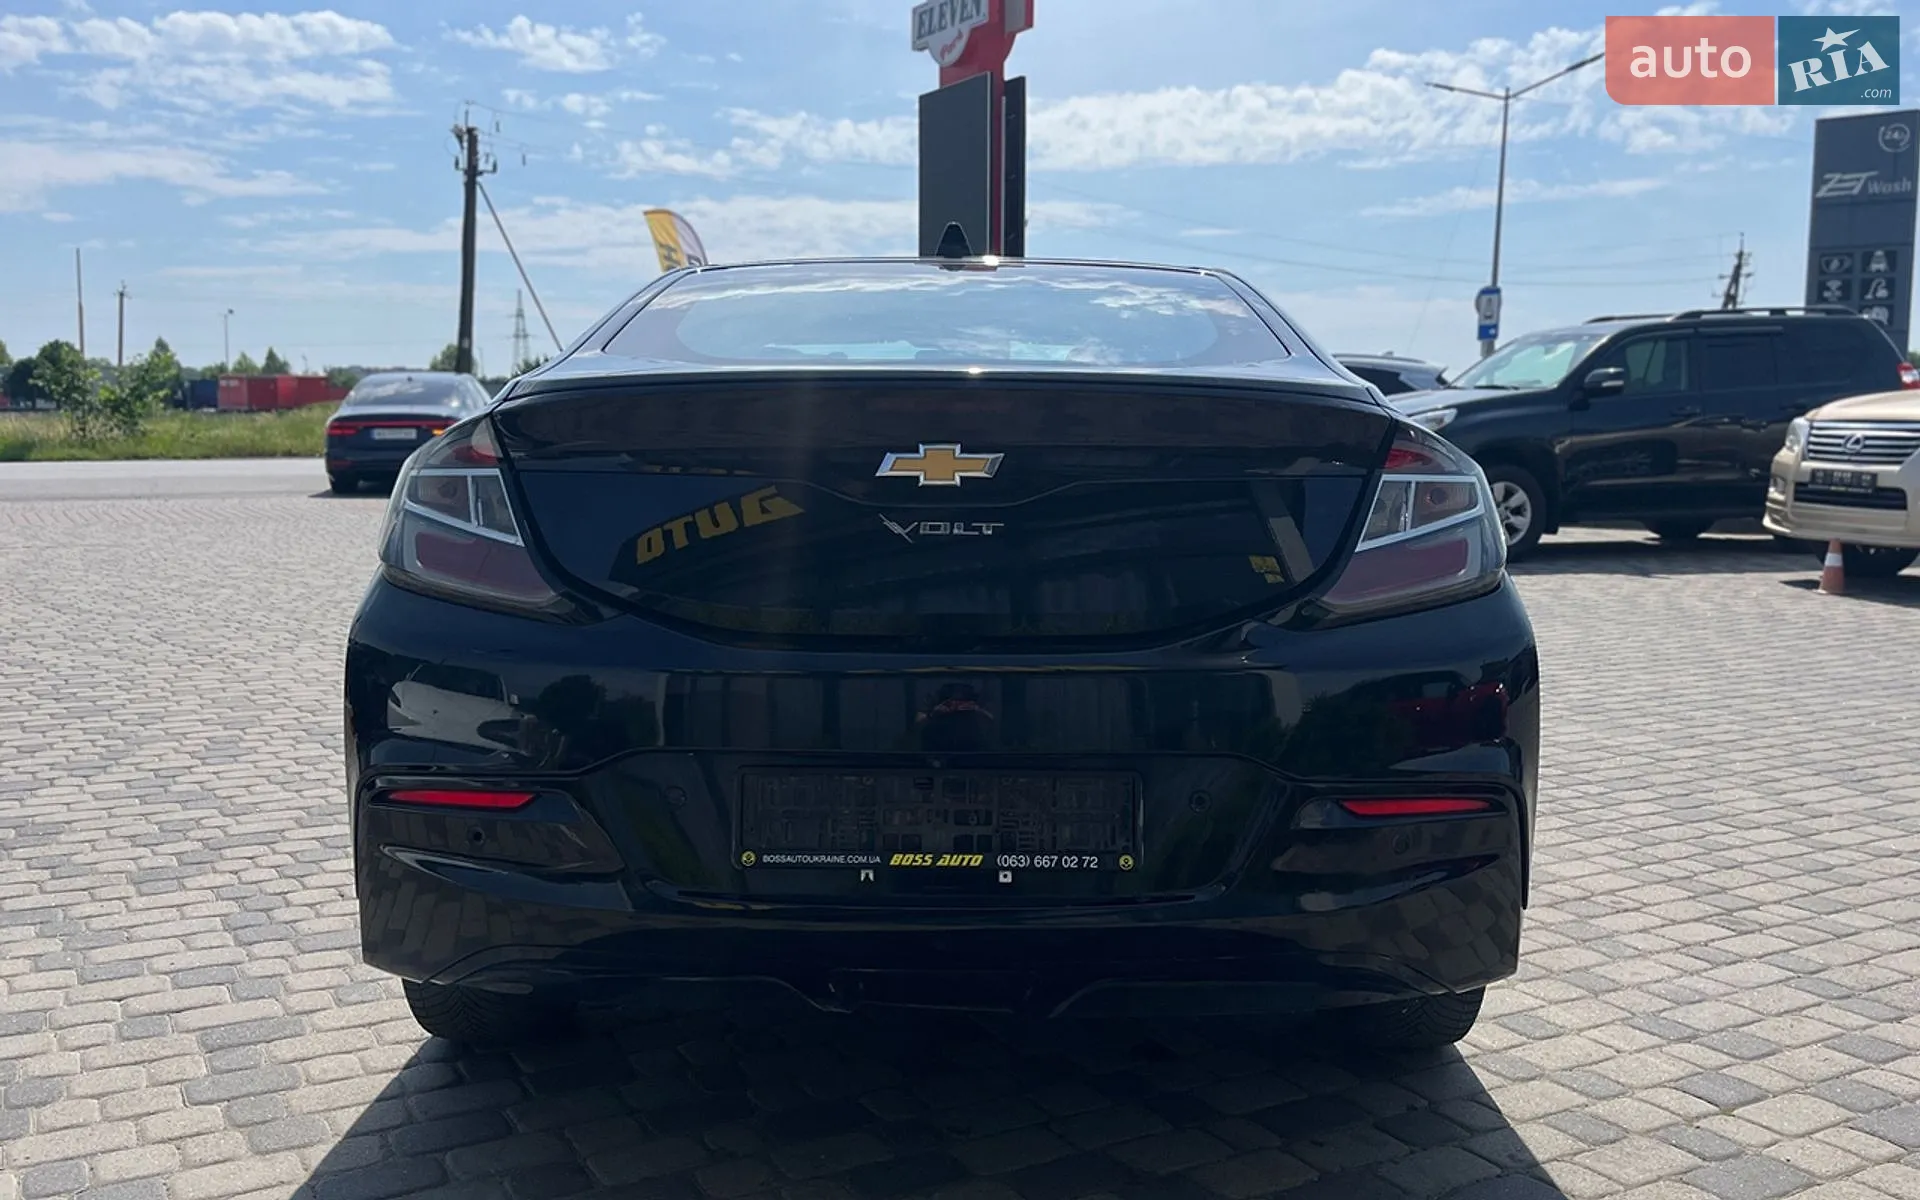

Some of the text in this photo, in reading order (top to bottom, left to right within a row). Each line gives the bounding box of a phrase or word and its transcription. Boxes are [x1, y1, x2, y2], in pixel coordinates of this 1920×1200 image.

[916, 0, 982, 39] ELEVEN
[1867, 176, 1912, 195] Wash
[879, 514, 1004, 543] VOLT
[762, 853, 1099, 869] BOSSAUTOUKRAINE.COM.UA BOSS AUTO (063) 667 02 72
